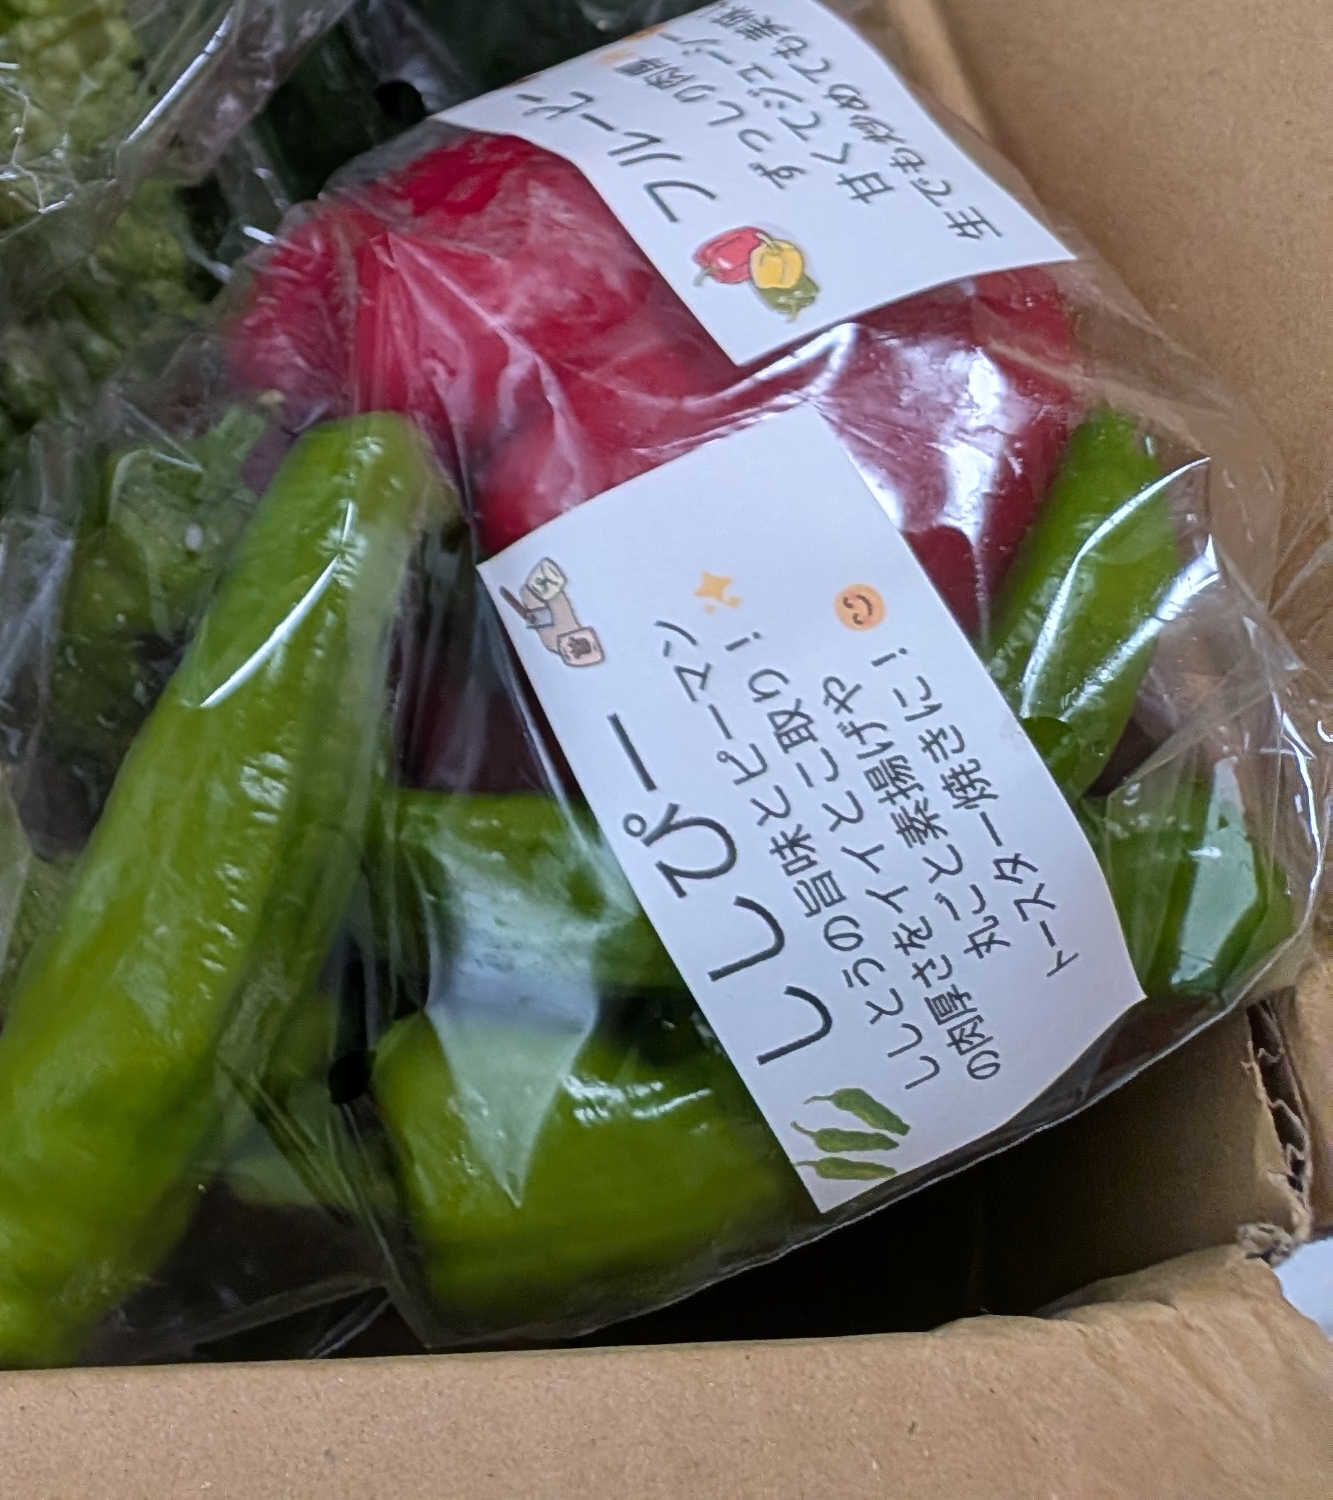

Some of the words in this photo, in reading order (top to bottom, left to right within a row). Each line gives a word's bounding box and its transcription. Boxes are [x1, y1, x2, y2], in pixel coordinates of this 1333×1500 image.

[613, 57, 806, 188] ずっしり肉厚
[659, 32, 893, 203] 甘くてジューシー
[609, 713, 833, 1065] ししぴー
[655, 619, 939, 1089] ししとうの旨味とピーマン
[727, 631, 1001, 1081] の肉厚さをイイとこ取り！
[823, 675, 1013, 960] 丸ごと素揚げや
[872, 647, 1079, 977] トースター焼きに！
